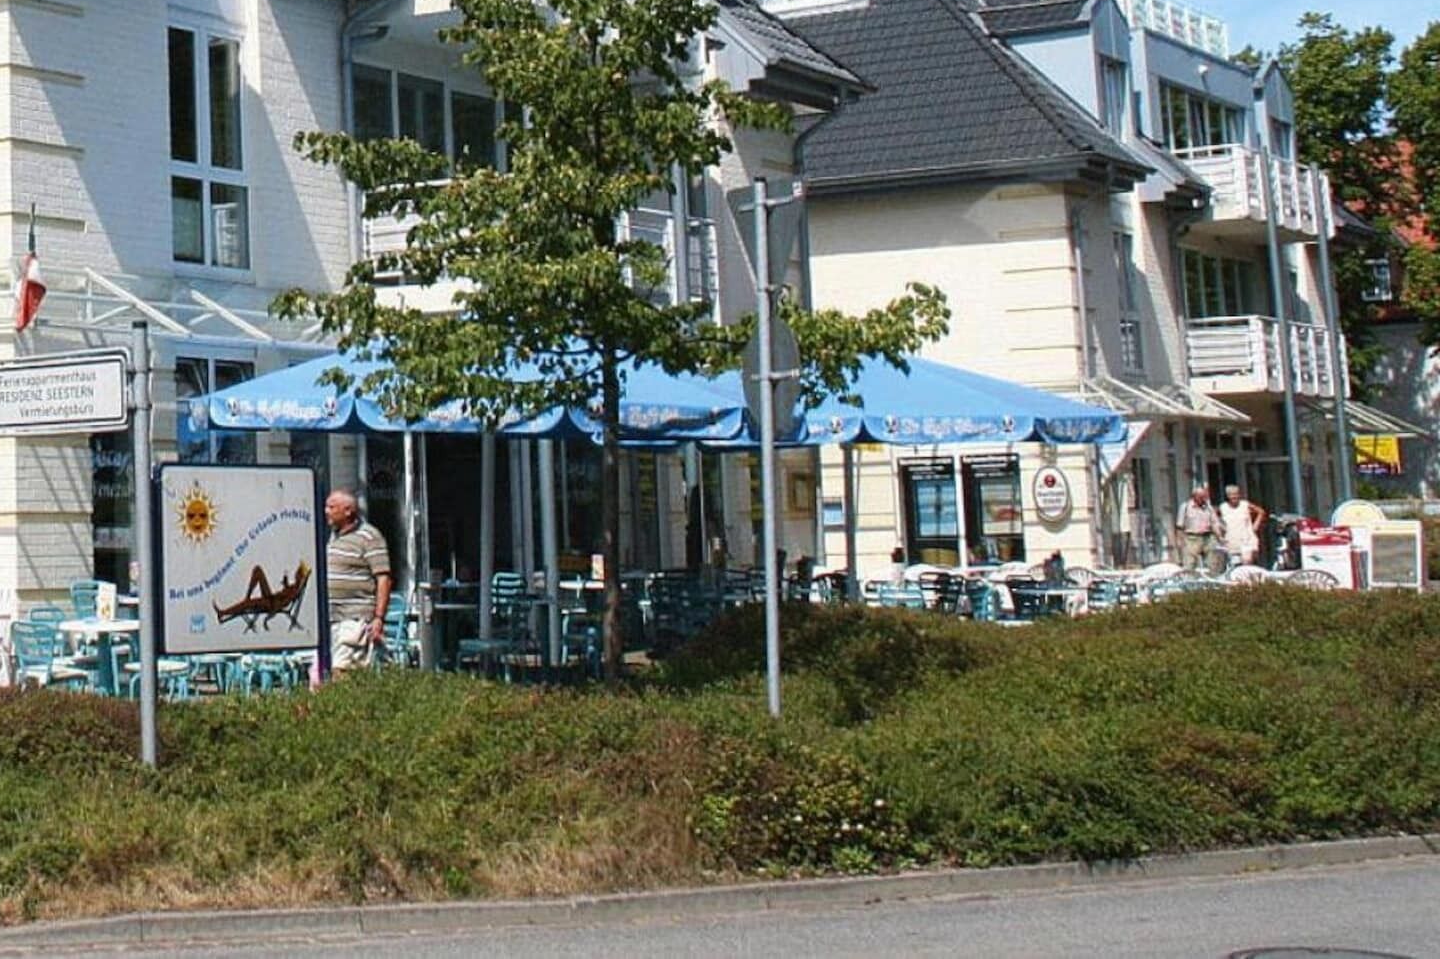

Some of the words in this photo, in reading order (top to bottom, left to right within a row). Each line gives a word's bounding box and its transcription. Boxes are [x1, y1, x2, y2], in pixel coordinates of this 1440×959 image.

[46, 386, 95, 401] SEESTERN
[169, 588, 185, 600] Bei
[187, 583, 204, 596] uns
